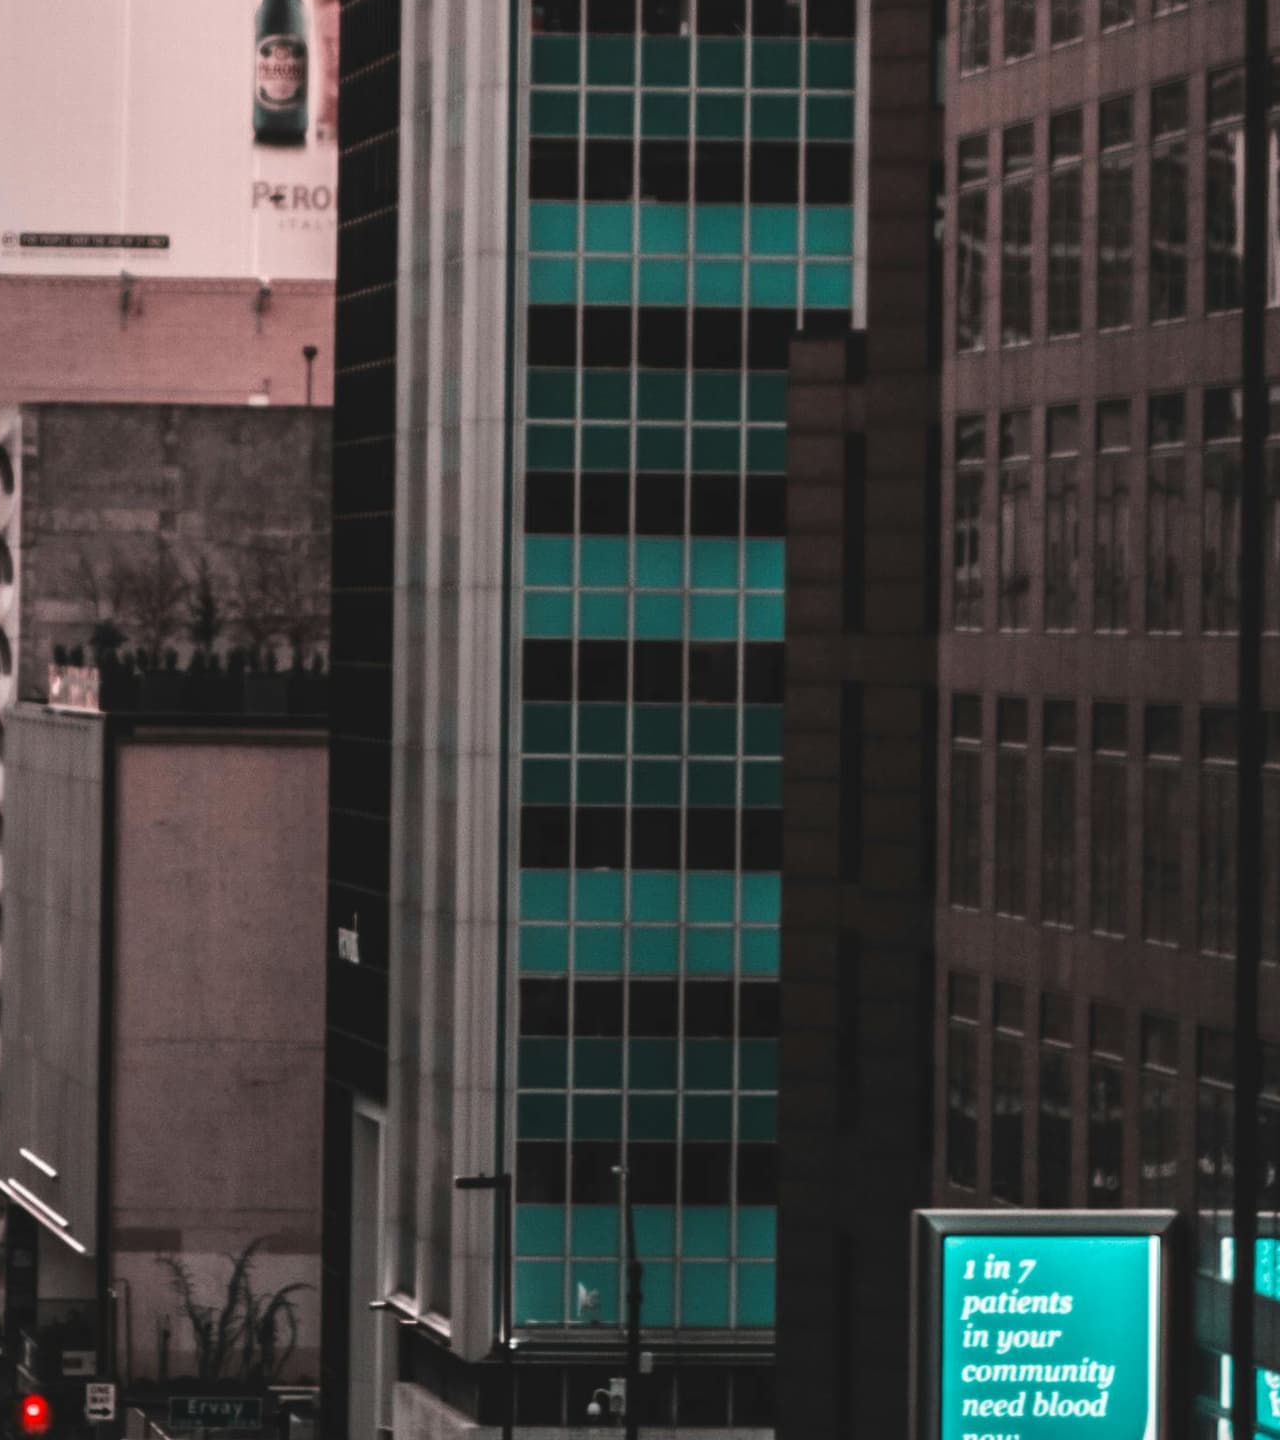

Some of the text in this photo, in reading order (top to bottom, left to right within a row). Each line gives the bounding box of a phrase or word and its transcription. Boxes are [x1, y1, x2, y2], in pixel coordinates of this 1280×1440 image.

[963, 1253, 1037, 1284] 1 in 7
[960, 1288, 1073, 1320] patients
[963, 1323, 1062, 1355] in your
[961, 1357, 1115, 1389] community
[187, 1399, 244, 1417] Ervay
[962, 1391, 1109, 1417] need blood
